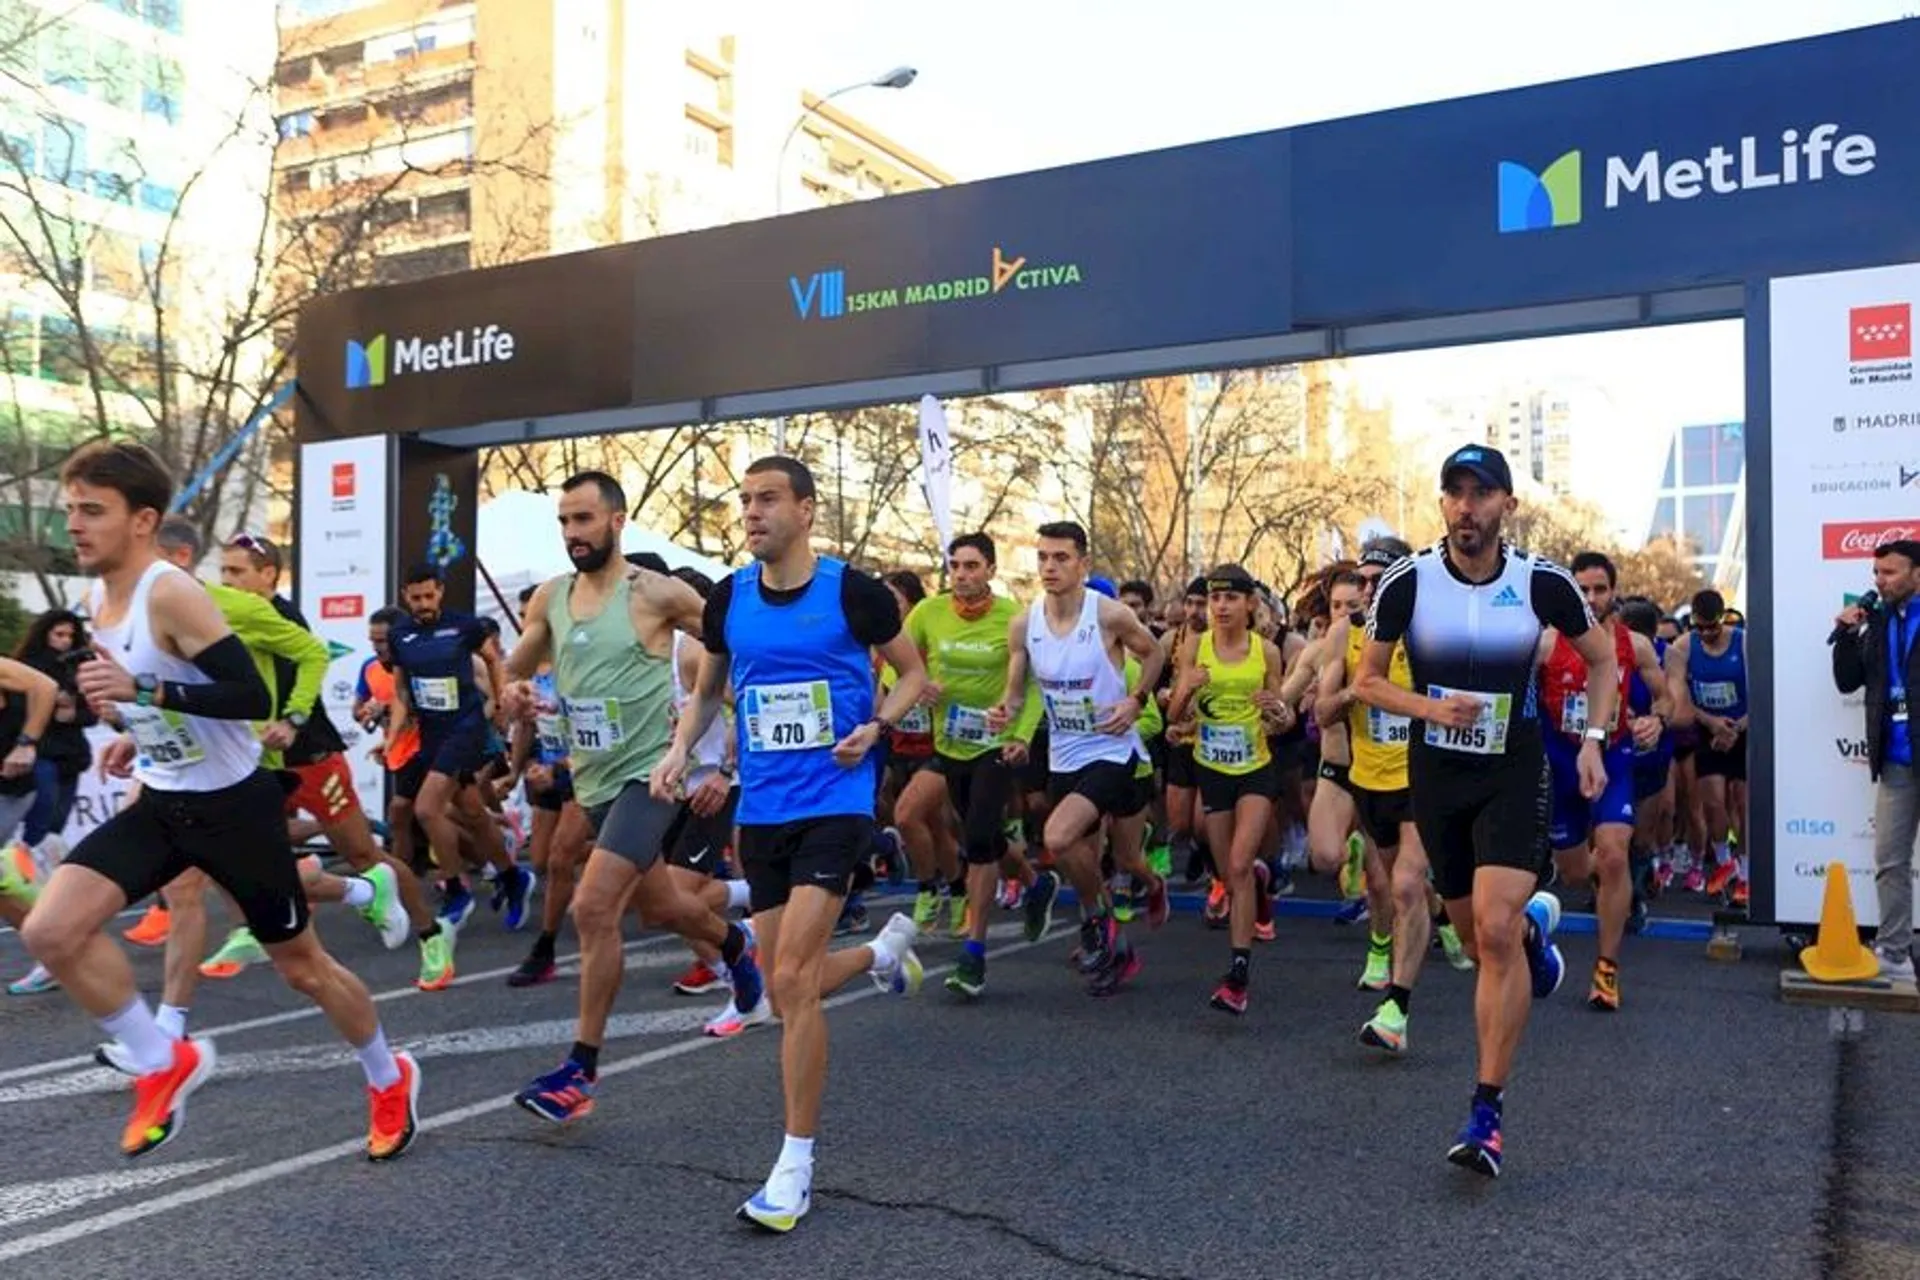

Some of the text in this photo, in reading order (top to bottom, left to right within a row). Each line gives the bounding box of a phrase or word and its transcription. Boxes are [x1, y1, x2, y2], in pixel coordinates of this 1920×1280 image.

[1604, 123, 1877, 208] MetLife
[789, 269, 845, 320] VIII
[847, 290, 898, 313] 15KM
[904, 276, 990, 305] MADRID
[393, 324, 515, 375] MetLife
[1849, 361, 1913, 374] Comunidad
[1850, 371, 1913, 385] de Madrid
[576, 728, 602, 749] 371
[771, 722, 806, 746] 470
[1387, 724, 1410, 742] 38
[1442, 723, 1488, 748] 1765
[1785, 818, 1836, 836] alsa
